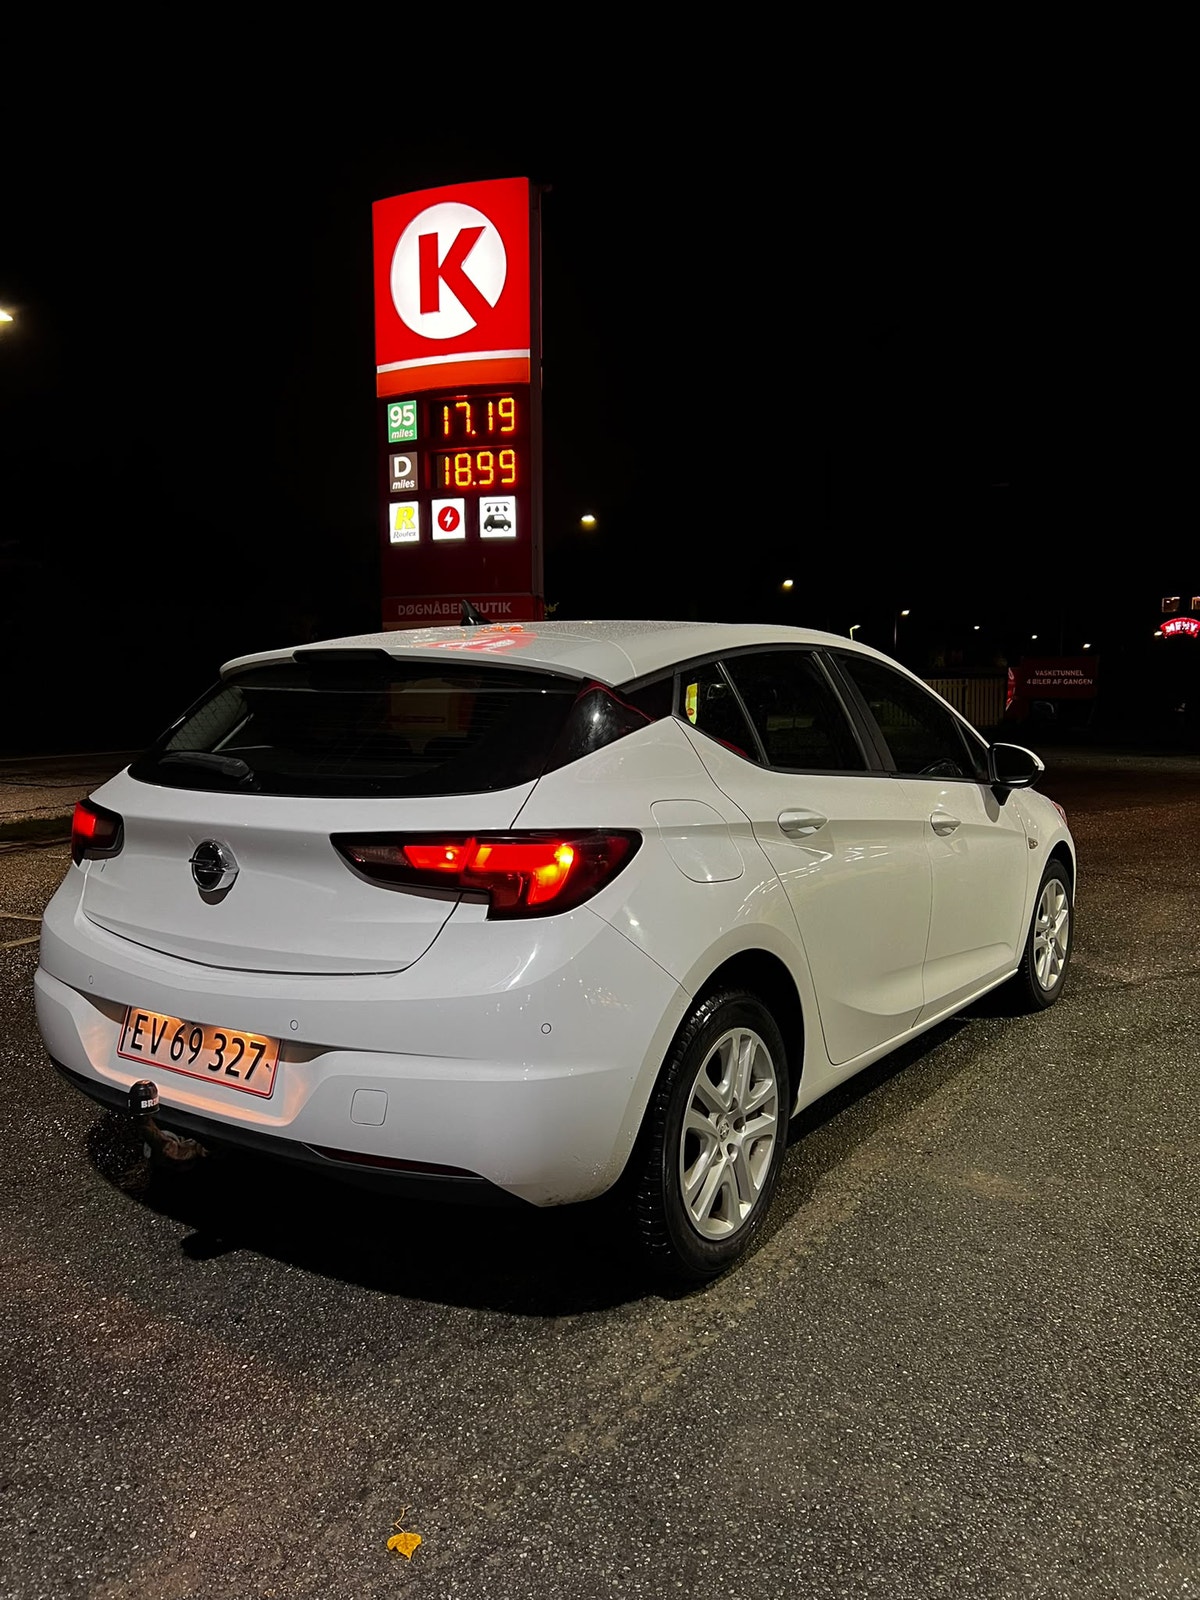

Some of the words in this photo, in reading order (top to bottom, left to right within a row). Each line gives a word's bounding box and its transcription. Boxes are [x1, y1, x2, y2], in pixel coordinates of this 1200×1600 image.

[418, 226, 493, 325] K
[390, 404, 415, 428] 95
[443, 397, 515, 435] 17.19
[391, 429, 414, 439] miles
[393, 456, 412, 478] D
[444, 449, 516, 487] 18.99
[392, 479, 415, 490] miles
[394, 505, 416, 531] R
[1034, 669, 1084, 677] VASKETUNNEL
[130, 1013, 168, 1055] EV
[170, 1022, 204, 1065] 69
[208, 1033, 267, 1080] 327
